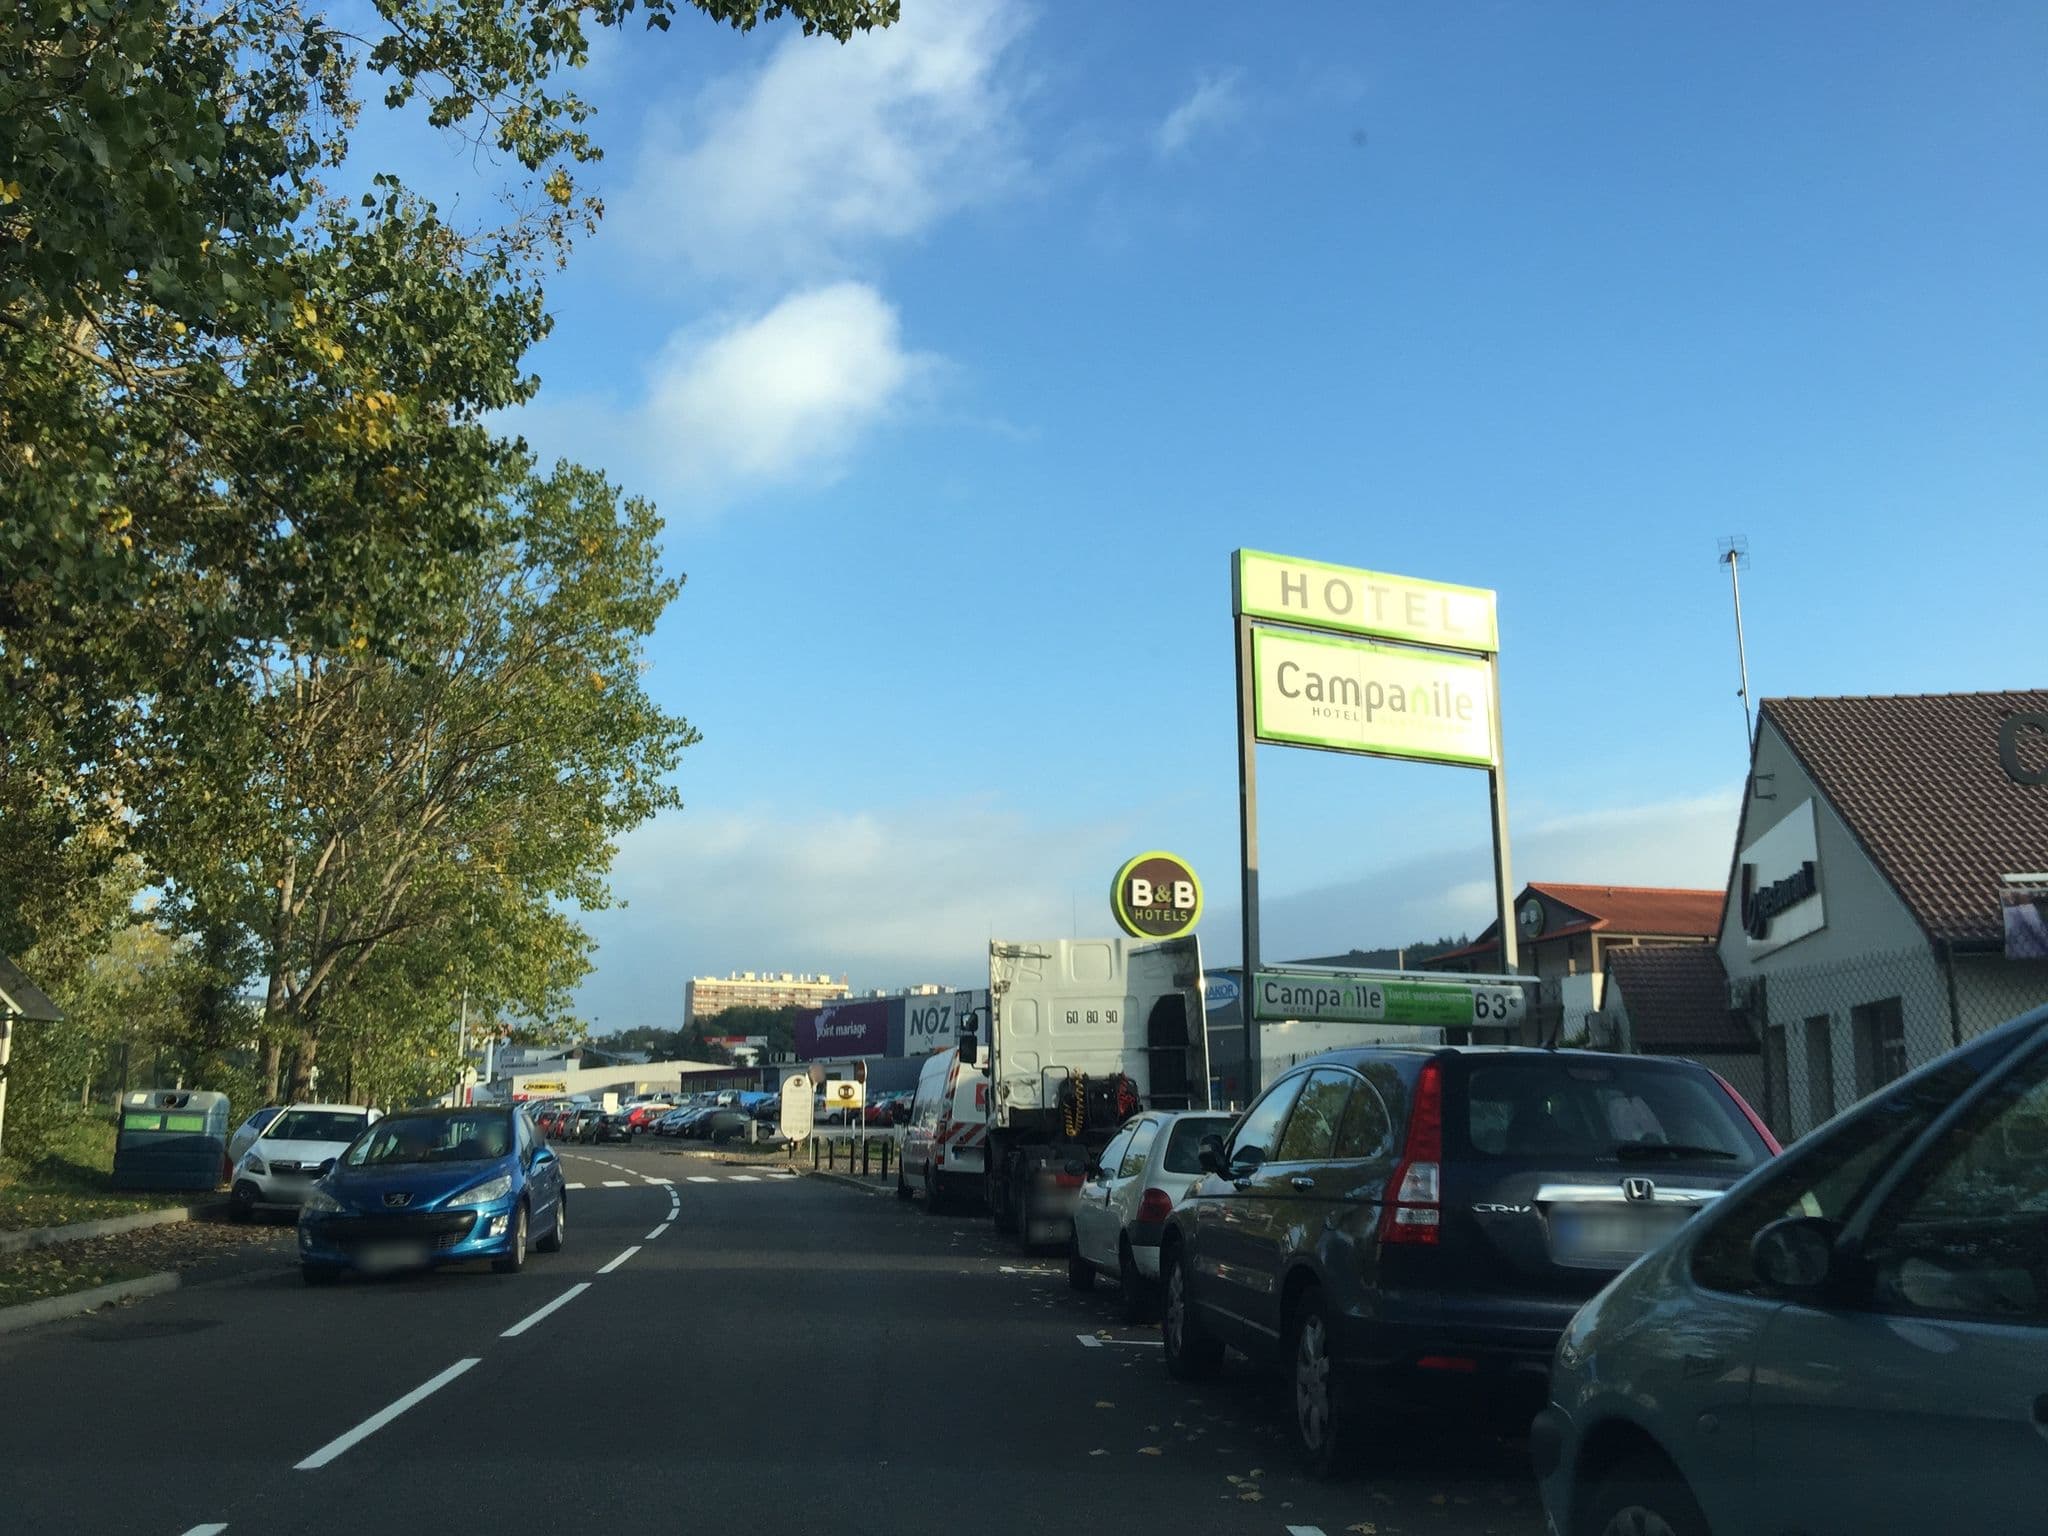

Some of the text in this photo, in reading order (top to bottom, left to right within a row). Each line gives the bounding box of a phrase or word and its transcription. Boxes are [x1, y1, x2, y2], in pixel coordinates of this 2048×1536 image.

[1281, 570, 1465, 633] HOTEL
[1277, 660, 1473, 722] Campanile
[1312, 706, 1360, 721] HOTEL
[1131, 878, 1196, 909] B&B
[1135, 909, 1189, 922] HOTELS
[1264, 982, 1381, 1014] Campanile
[910, 1006, 952, 1036] NOZ
[1066, 1010, 1118, 1024] 60 80 90
[1283, 1006, 1312, 1015] HOTEL
[835, 1020, 867, 1039] mariage
